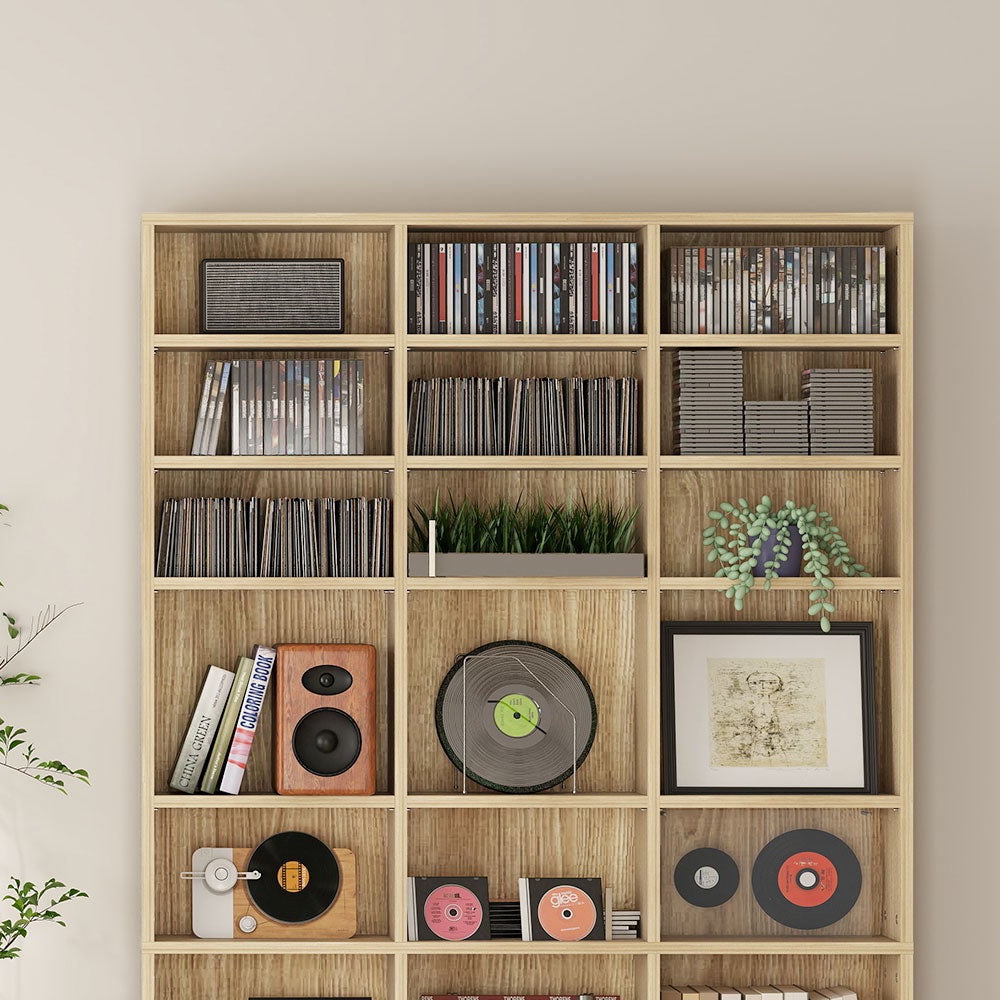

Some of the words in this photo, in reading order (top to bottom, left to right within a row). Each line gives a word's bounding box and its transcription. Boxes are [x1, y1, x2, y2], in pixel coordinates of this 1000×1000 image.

[241, 683, 265, 729] COLORING
[254, 655, 274, 682] BOOK
[178, 754, 199, 789] CHINA
[192, 715, 212, 752] GREEN
[550, 893, 578, 908] glee
